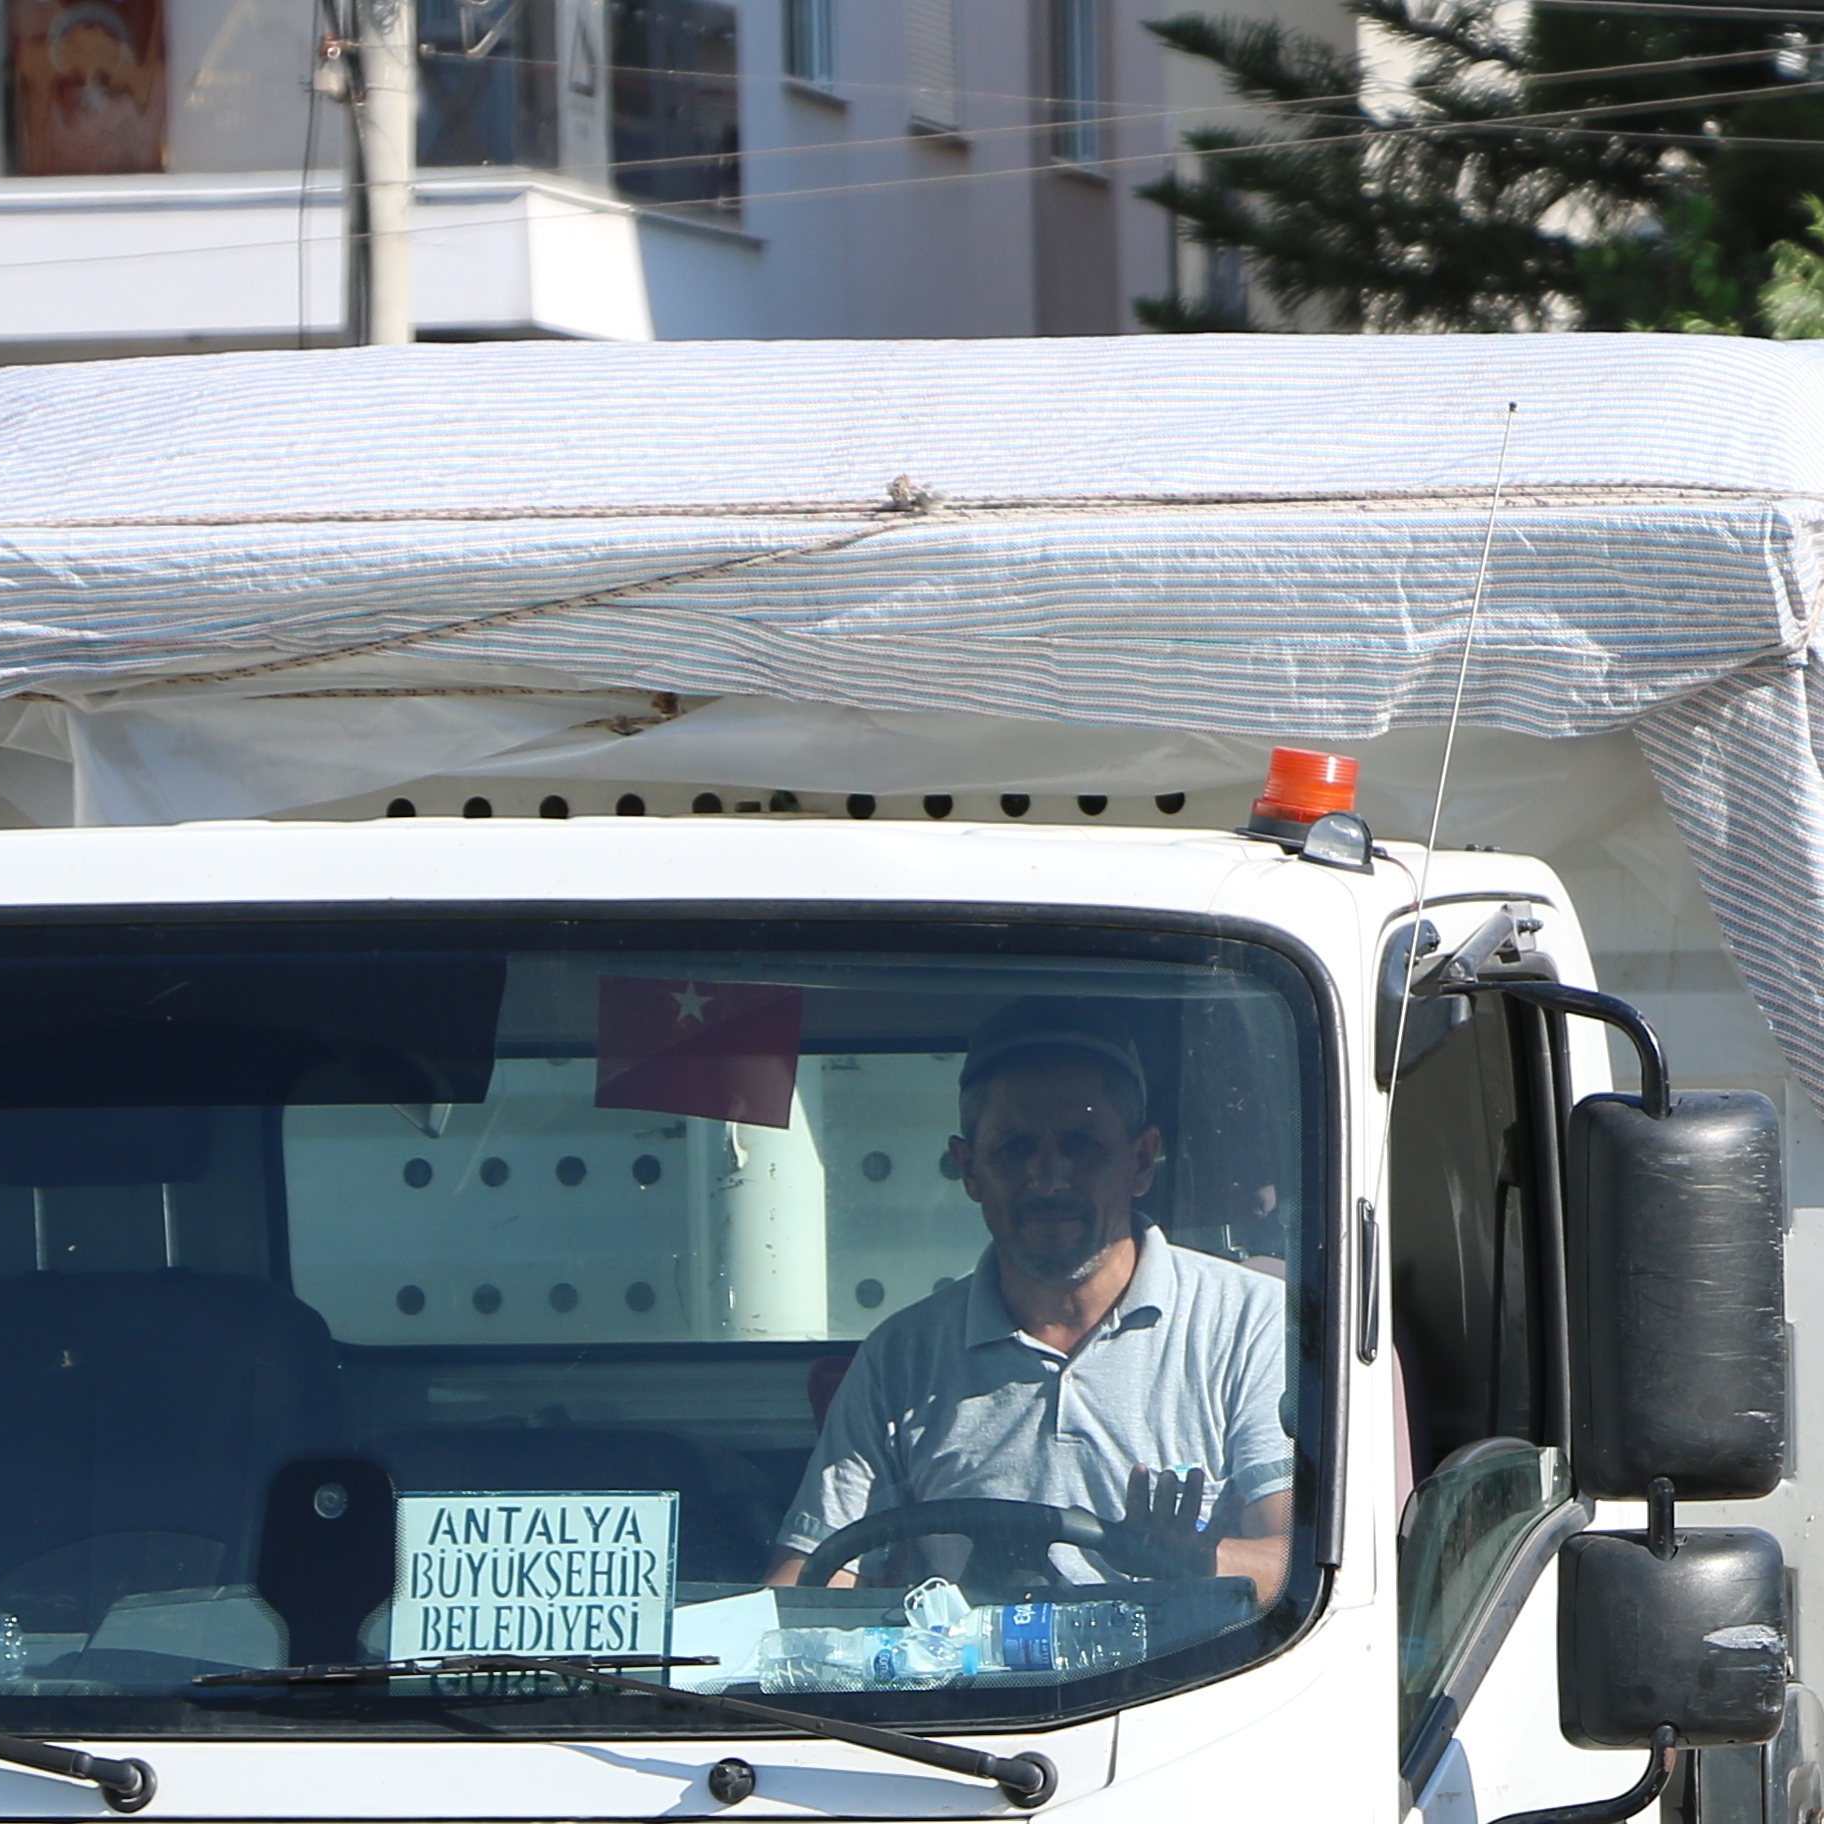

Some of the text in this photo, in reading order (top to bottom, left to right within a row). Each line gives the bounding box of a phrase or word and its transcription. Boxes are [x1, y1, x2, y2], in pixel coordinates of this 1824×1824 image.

[428, 1506, 643, 1546] ANTALYA
[409, 1546, 661, 1600] BÜYÜKŞEHİR
[419, 1601, 639, 1652] BELEDİYESİ
